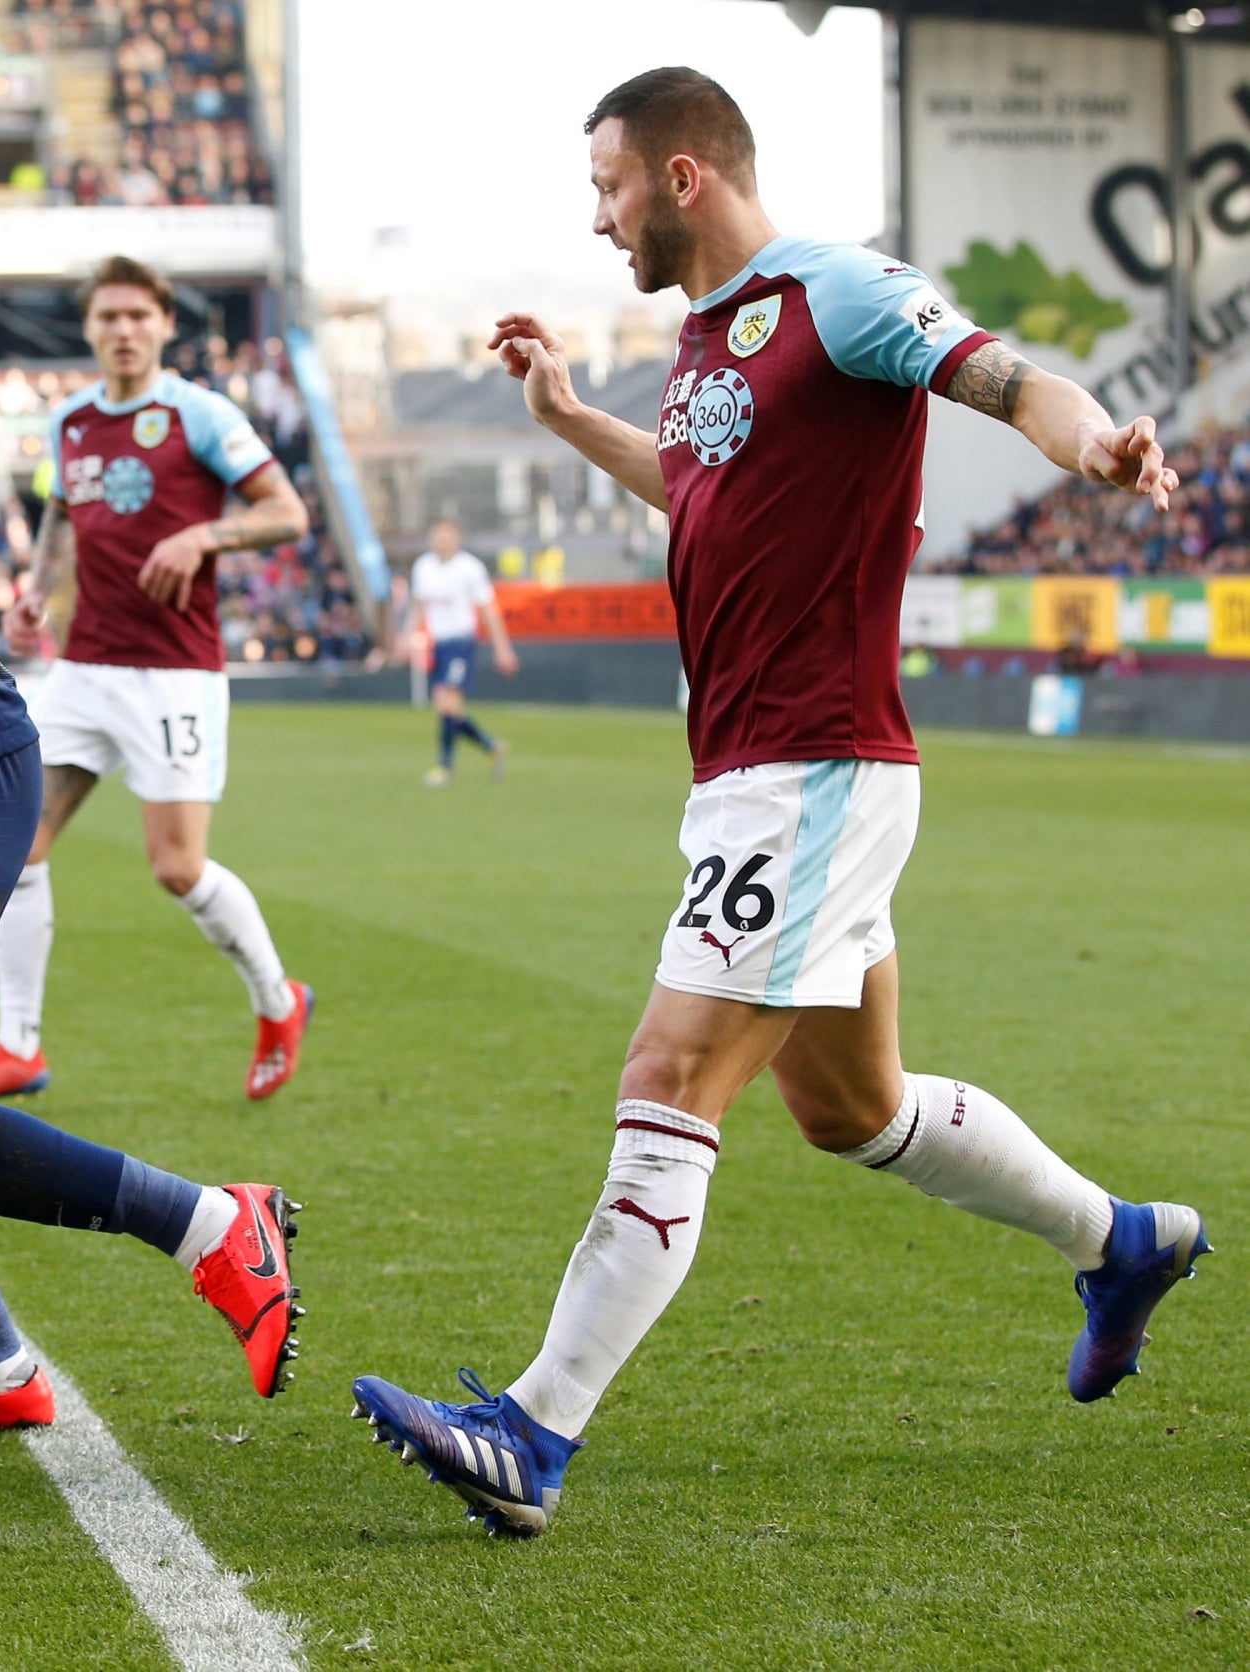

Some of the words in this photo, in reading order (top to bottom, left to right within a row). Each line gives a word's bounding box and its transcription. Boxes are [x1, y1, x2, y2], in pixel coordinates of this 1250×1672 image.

[657, 408, 688, 452] LaBa
[697, 402, 732, 429] 360
[160, 714, 201, 757] 13
[677, 853, 774, 932] 26
[950, 1082, 966, 1127] BFC
